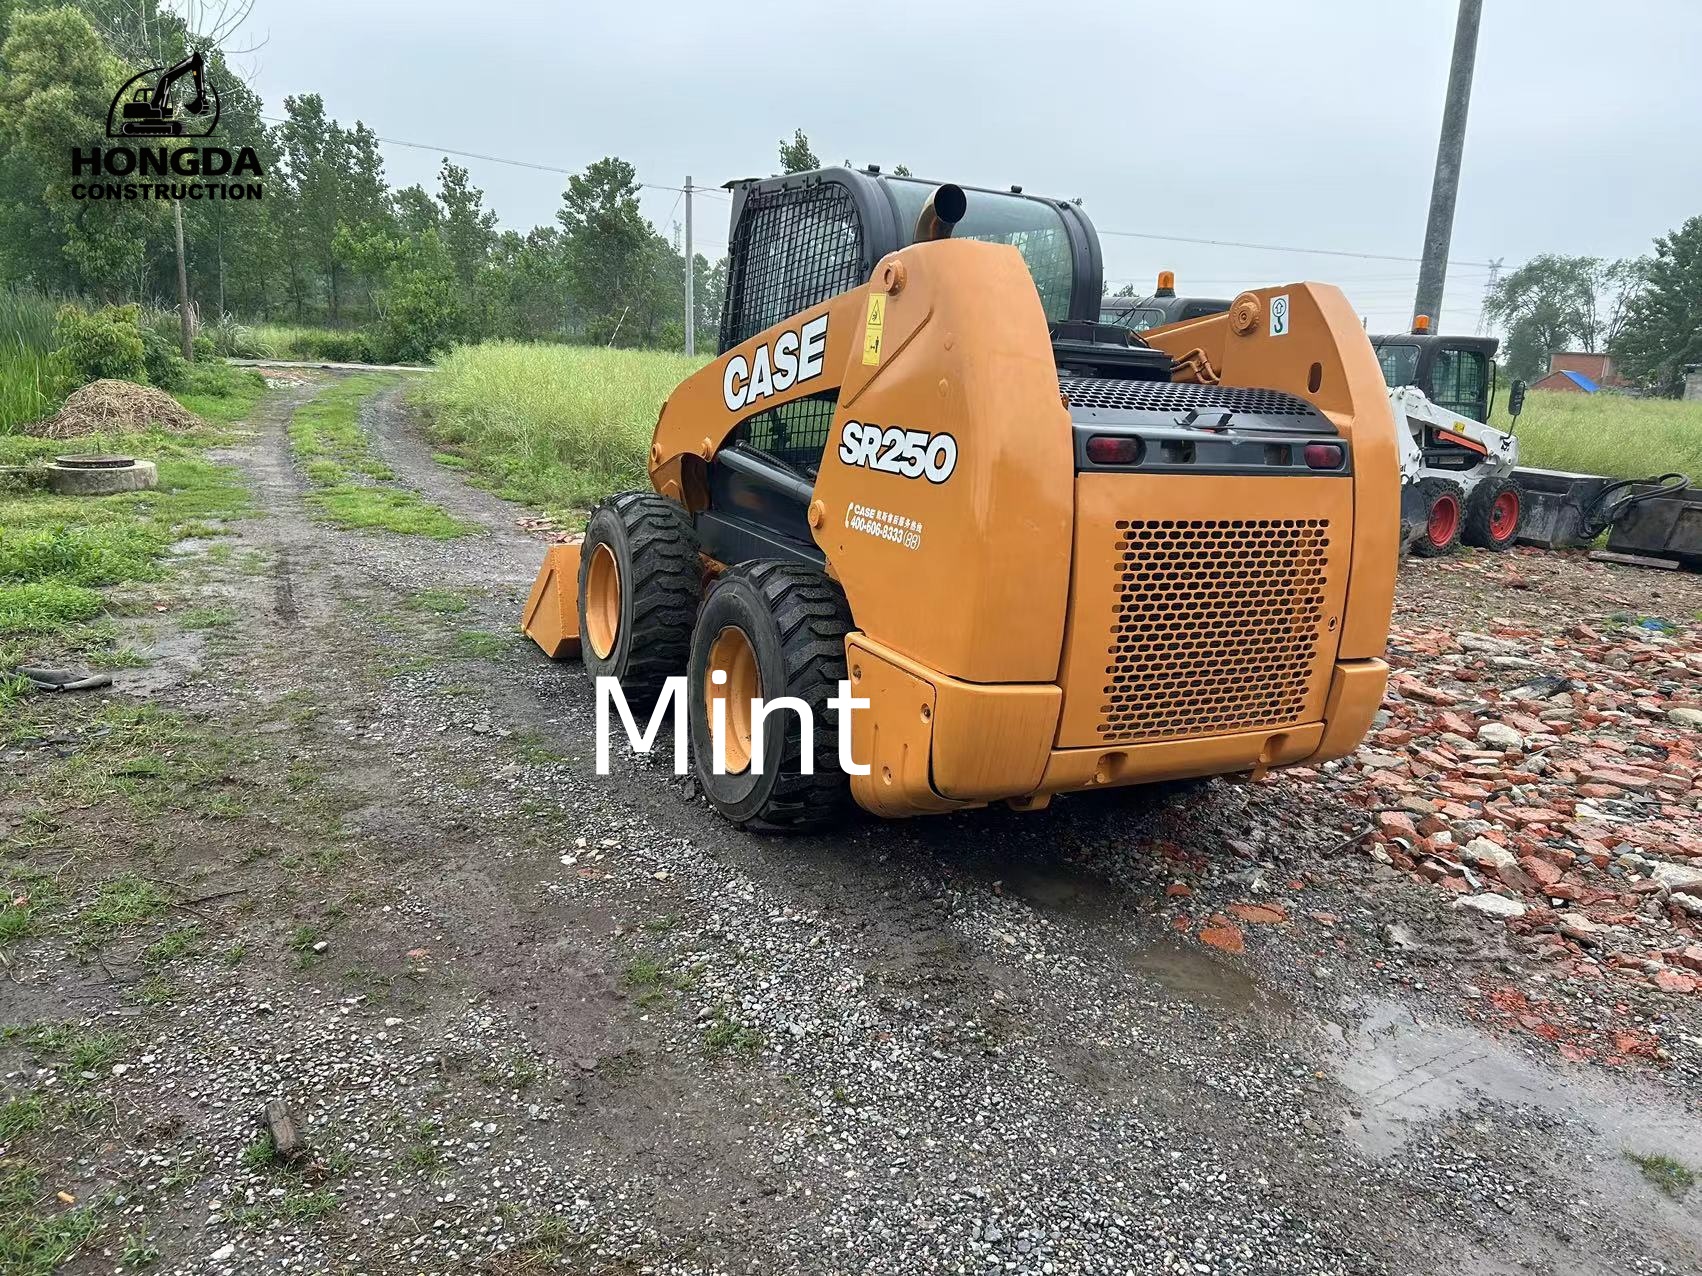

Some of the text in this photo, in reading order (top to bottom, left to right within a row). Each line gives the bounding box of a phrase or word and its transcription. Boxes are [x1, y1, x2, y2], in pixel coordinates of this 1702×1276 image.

[722, 311, 829, 412] CASE
[838, 420, 958, 484] SR250
[854, 504, 876, 520] CASE
